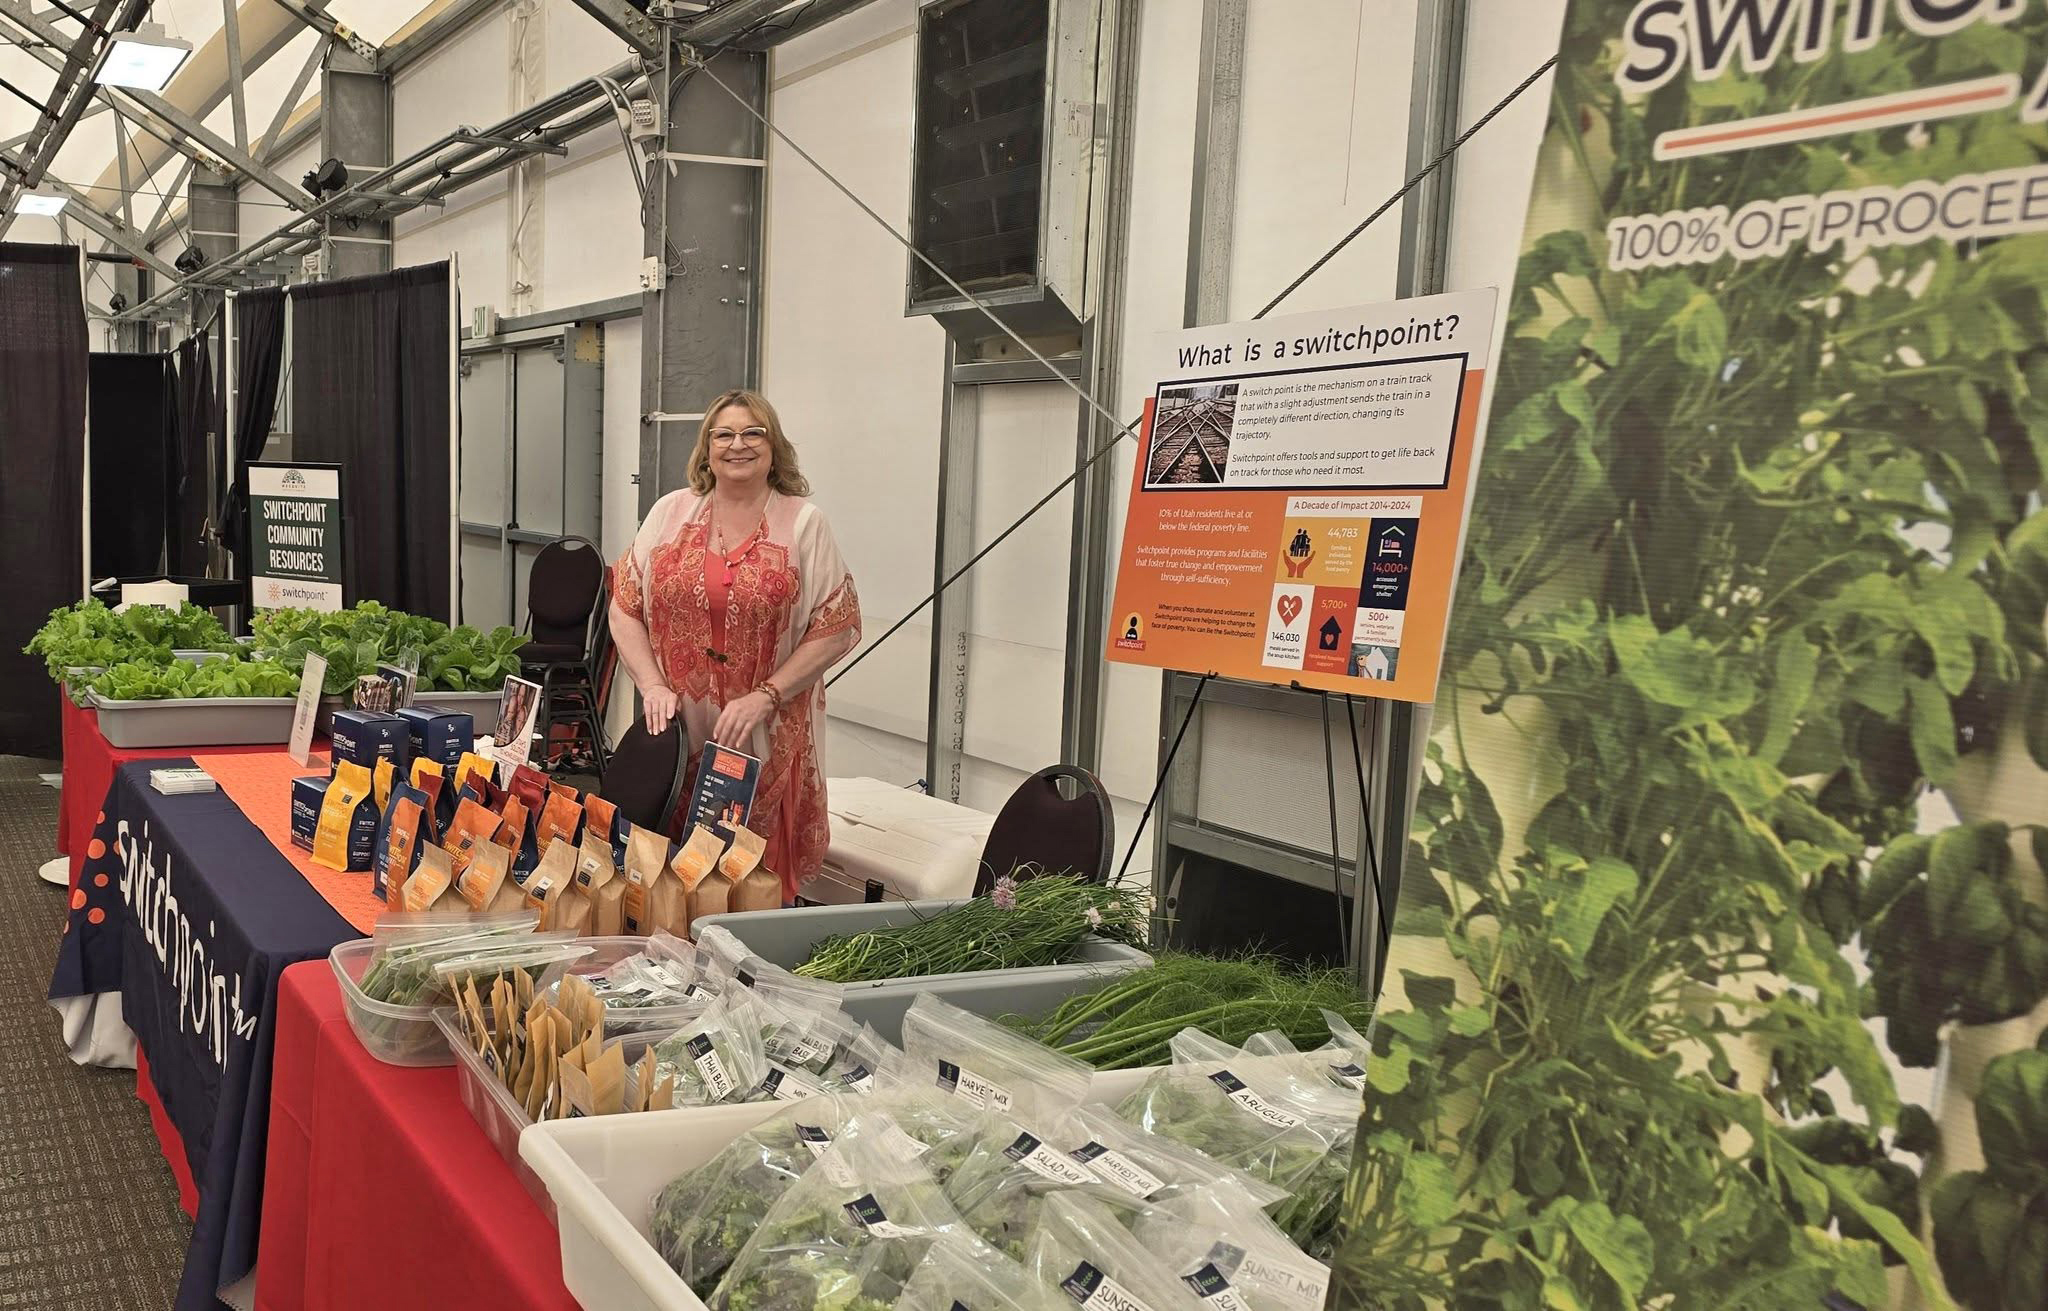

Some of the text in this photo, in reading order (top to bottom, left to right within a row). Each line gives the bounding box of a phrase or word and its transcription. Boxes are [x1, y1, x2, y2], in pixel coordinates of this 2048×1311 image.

[1616, 175, 2048, 262] 100% OF PROCEE
[1178, 314, 1460, 369] What is a switchpoint?
[1249, 387, 1272, 396] switch
[1274, 385, 1294, 396] point
[1295, 384, 1302, 392] is
[1304, 383, 1316, 392] the
[1317, 380, 1365, 392] mechanism
[1387, 375, 1406, 385] train
[1409, 373, 1432, 384] track
[1240, 403, 1256, 412] that
[1256, 400, 1272, 410] with
[1280, 400, 1301, 410] slight
[1302, 396, 1348, 408] adjustment
[1350, 393, 1374, 404] sends
[1376, 392, 1390, 402] the
[1392, 390, 1412, 400] train
[1414, 390, 1423, 399] in
[1425, 390, 1430, 398] a
[1238, 406, 1404, 426] completely different direction, changing its
[1236, 430, 1272, 441] trajectory.
[1232, 446, 1435, 463] Switchpoint offers tools and support to get life back
[1240, 468, 1258, 476] track
[1260, 467, 1270, 476] for
[1272, 466, 1294, 476] those
[1294, 466, 1312, 475] who
[1312, 466, 1334, 475] need
[1334, 465, 1340, 474] it
[1342, 466, 1364, 474] most.
[264, 500, 326, 522] SWITCHPOINT
[1159, 508, 1172, 518] 10%
[1173, 508, 1180, 518] of
[1180, 508, 1195, 518] Utah
[1196, 509, 1224, 518] residents
[1224, 510, 1235, 518] live
[1245, 510, 1253, 518] or
[1294, 501, 1411, 511] A Decade of Impact 2014-2024
[1159, 522, 1250, 533] below the federal poverty line.
[1328, 528, 1358, 538] 44,783
[268, 525, 324, 547] COMMUNITY
[1136, 545, 1268, 558] Switchpoint provides programs and facilities
[270, 550, 324, 572] RESOURCES
[1136, 558, 1262, 573] that foster true change and empowerment
[1372, 562, 1409, 574] 14,000+
[1160, 573, 1231, 586] through self-sufficiency.
[282, 588, 325, 600] switchpoint
[1321, 599, 1348, 608] 5,700+
[1154, 613, 1182, 621] Switchpoint
[1201, 618, 1220, 626] helping
[1226, 620, 1246, 628] change
[1368, 612, 1389, 621] 500+
[1272, 632, 1300, 642] 146,030
[704, 1055, 728, 1096] THAI BASIL
[994, 1093, 1008, 1106] MIX
[1238, 1094, 1296, 1126] ARUGULA
[1034, 1152, 1064, 1174] SALAD
[1063, 1168, 1081, 1182] MIX
[1101, 1156, 1153, 1190] HARVEST MIX
